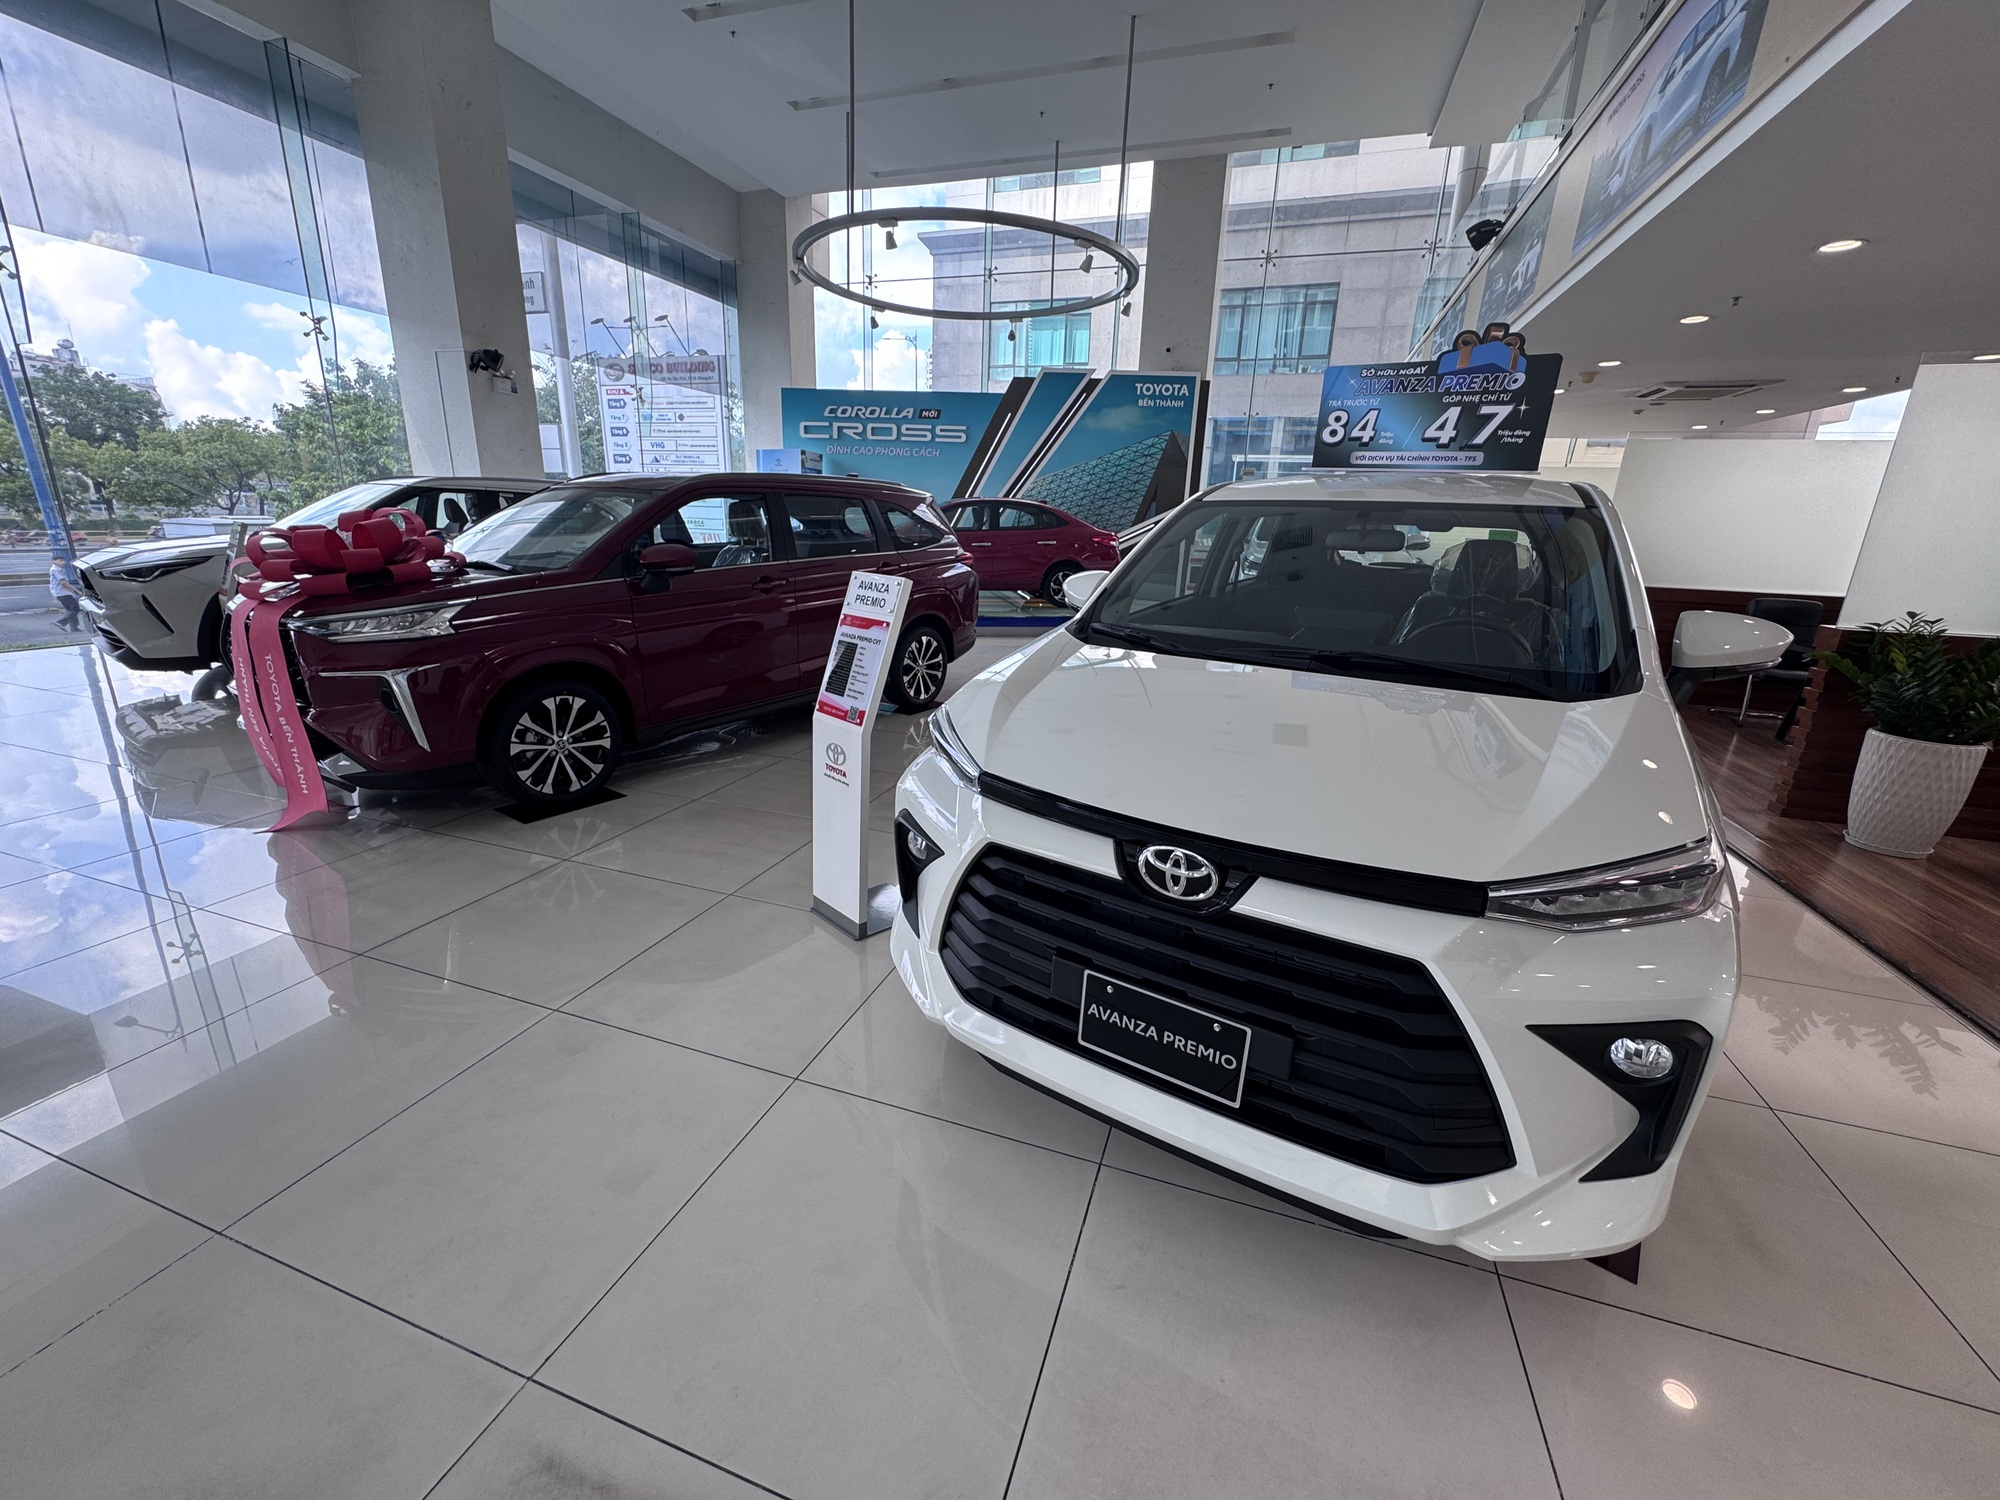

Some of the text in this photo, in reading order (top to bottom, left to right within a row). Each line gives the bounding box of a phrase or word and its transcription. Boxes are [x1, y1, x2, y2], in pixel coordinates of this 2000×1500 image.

[627, 361, 716, 374] SCO BUILDING
[1361, 367, 1376, 377] SỞ
[1399, 365, 1429, 375] NGAY
[1135, 383, 1189, 397] TOYOTA
[1354, 371, 1526, 396] AVANZA PREMIO
[1138, 398, 1184, 408] BẾN THÀNH
[1442, 394, 1462, 403] GÓP
[1462, 394, 1481, 404] NHẸ
[823, 405, 938, 419] COROLLA MỚI
[799, 421, 968, 444] CROSS
[1321, 408, 1381, 446] 84
[650, 441, 666, 449] VHG
[853, 446, 874, 455] CAO
[875, 446, 911, 457] PHONG
[912, 446, 940, 457] CÁCH
[1355, 454, 1367, 462] VỚI
[1368, 455, 1385, 463] DỊCH
[1407, 454, 1431, 462] CHÍNH
[857, 580, 890, 594] AVANZA
[854, 594, 886, 608] PREMIO
[840, 632, 882, 646] AVANZA PREMIO CVT
[264, 654, 309, 795] TOYOTA BẾN THÀNH
[825, 762, 848, 779] TOYOTA
[1087, 1003, 1237, 1070] AVANZA PREMIO
